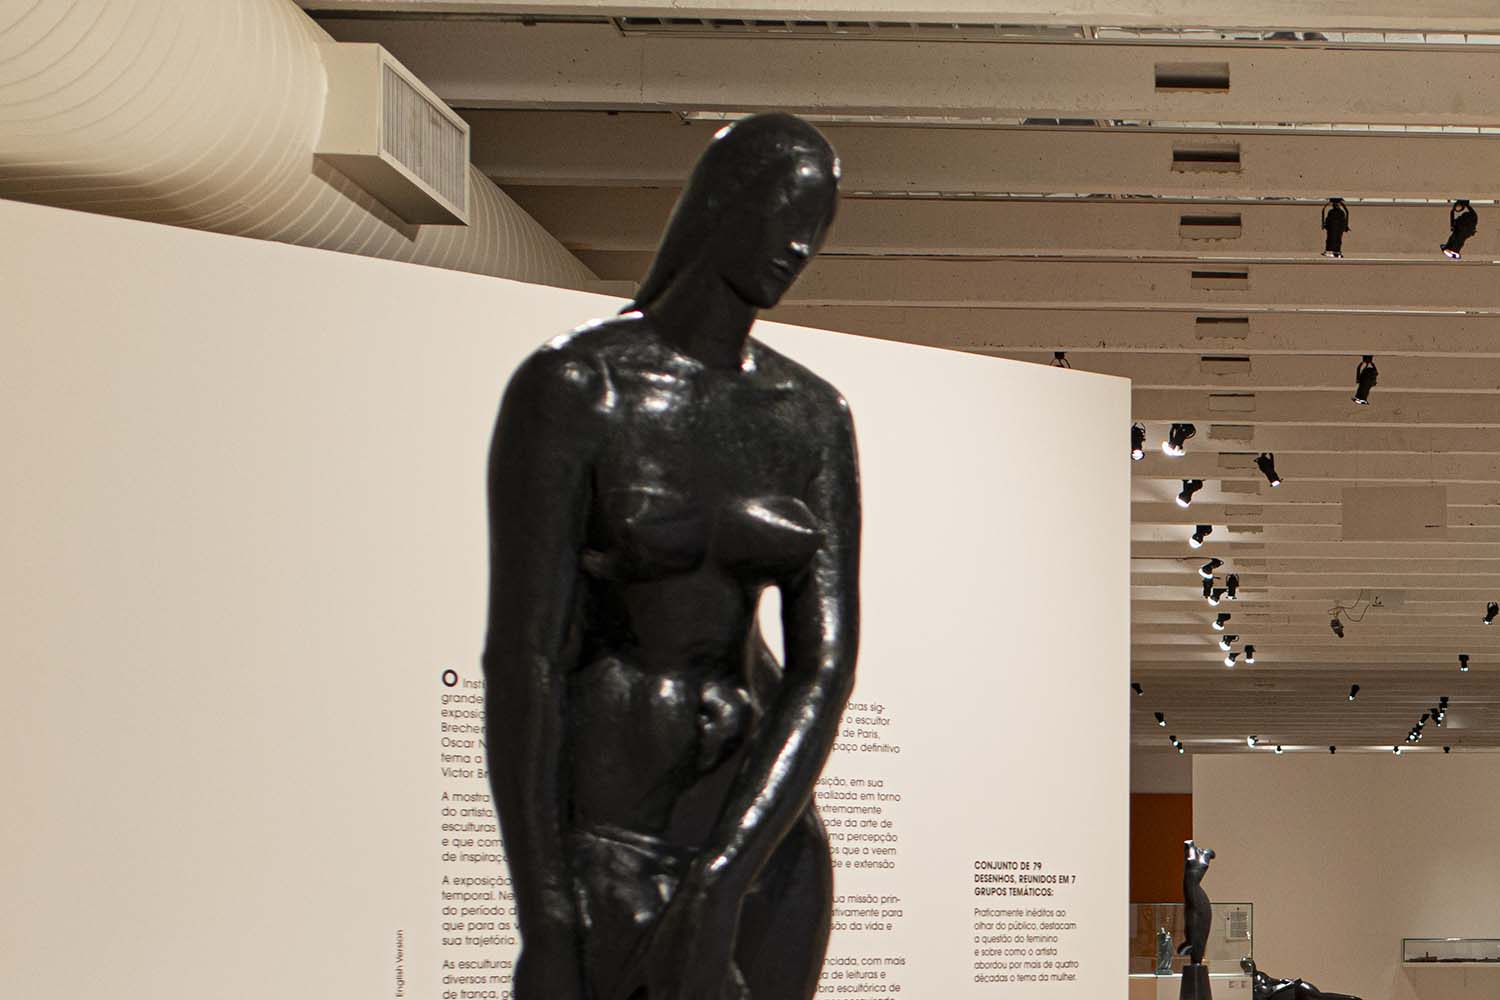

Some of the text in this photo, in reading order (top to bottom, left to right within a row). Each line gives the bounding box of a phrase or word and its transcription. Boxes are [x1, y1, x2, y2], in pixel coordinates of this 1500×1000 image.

[442, 669, 458, 687] O
[855, 715, 890, 726] escultor
[441, 736, 474, 748] Oscar
[860, 742, 900, 753] definitivo
[441, 767, 473, 778] Victor
[452, 790, 490, 802] mostra
[441, 808, 456, 816] do
[441, 820, 498, 832] esculturas
[844, 818, 892, 828] da arte de
[847, 832, 897, 842] percepção
[842, 847, 860, 855] que
[854, 858, 894, 868] extensão
[974, 860, 1041, 870] CONJUNTO DE 79
[1019, 874, 1056, 883] REUNIDOS
[1058, 875, 1068, 883] EM
[974, 887, 1006, 896] GRUPOS
[848, 894, 900, 904] missão prin-
[442, 904, 505, 917] do período
[974, 908, 1023, 917] Praticamente
[395, 929, 405, 997] English Version
[442, 959, 514, 972] As esculturas
[442, 974, 486, 984] diversos
[831, 971, 843, 979] de
[846, 970, 878, 979] leituras
[836, 983, 900, 992] escultórica de
